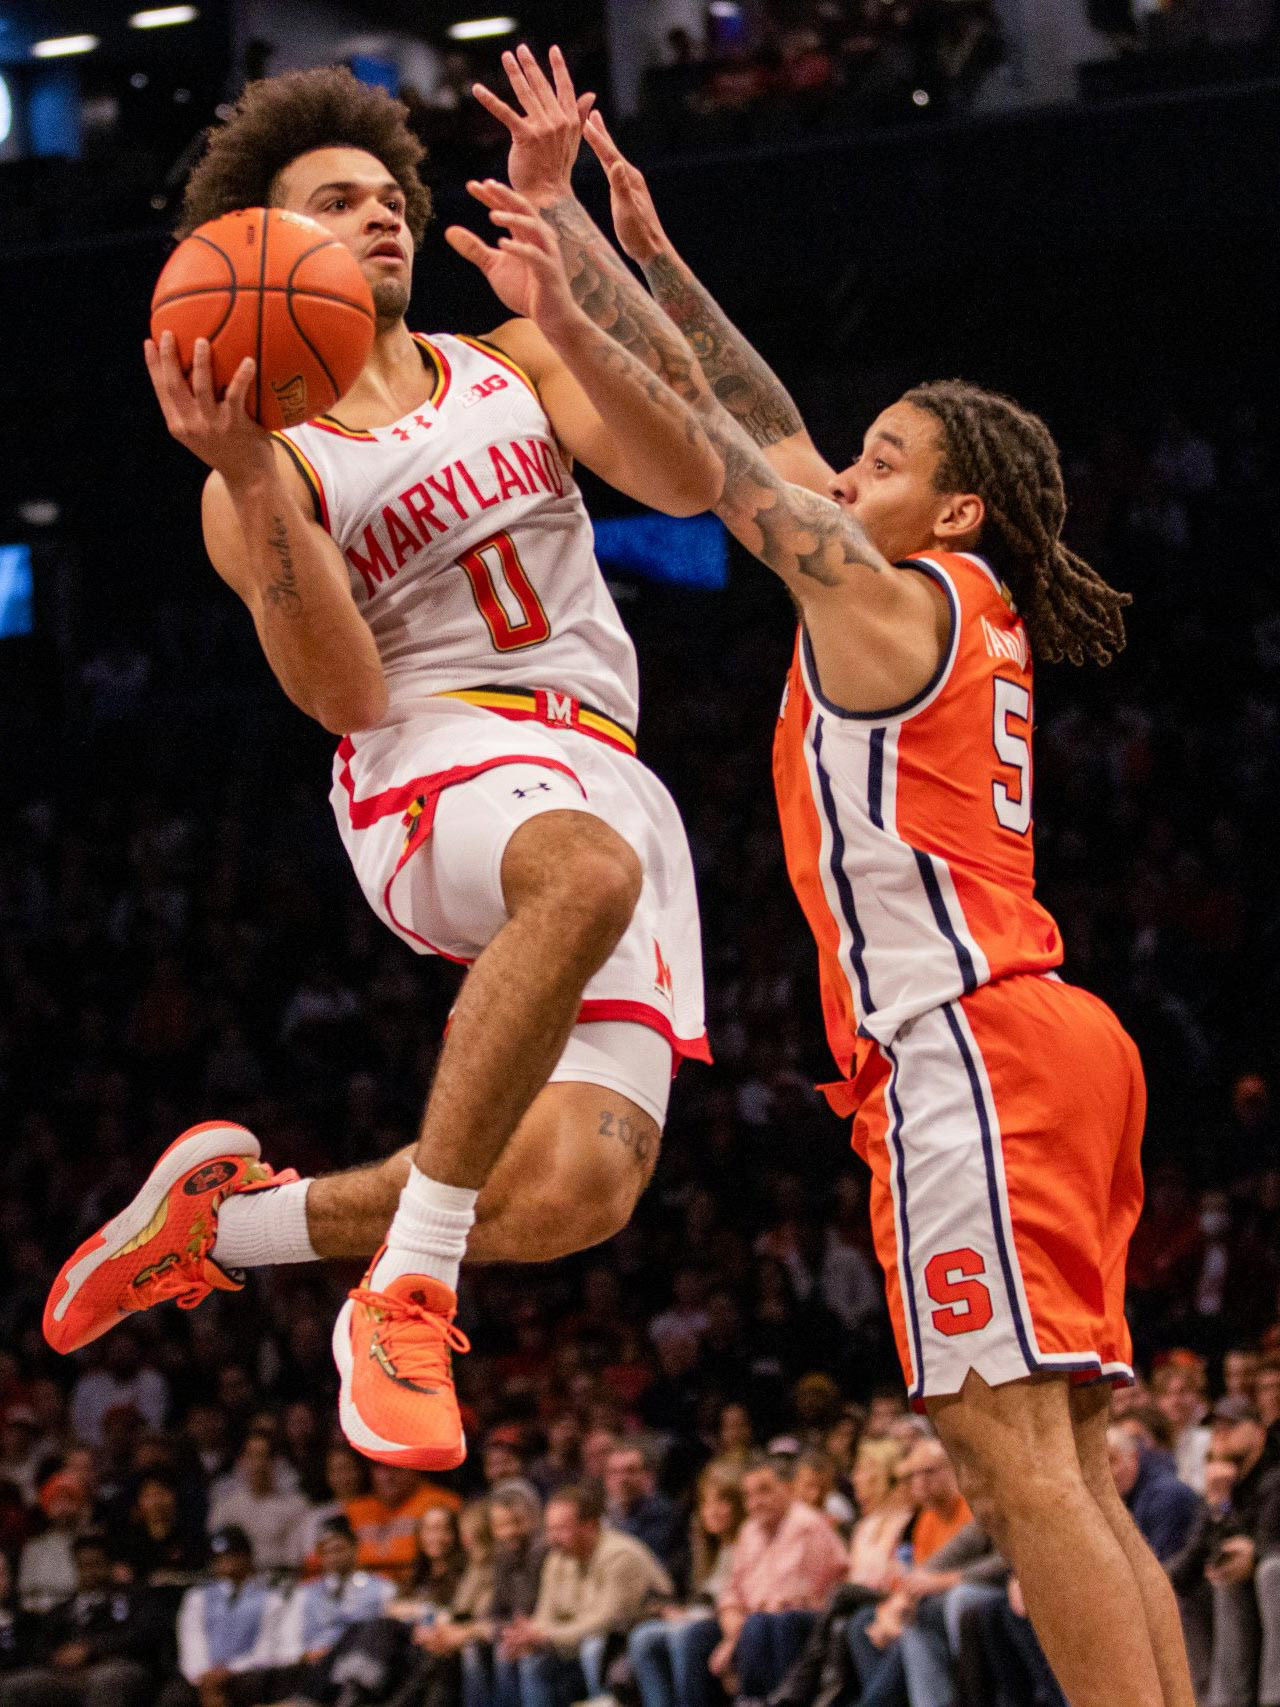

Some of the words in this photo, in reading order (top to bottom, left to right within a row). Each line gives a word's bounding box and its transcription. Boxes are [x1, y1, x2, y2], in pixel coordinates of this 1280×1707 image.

[345, 439, 563, 600] MARYLAND
[454, 528, 551, 653] 0
[546, 691, 572, 726] M
[992, 675, 1030, 837] 5
[924, 1247, 994, 1337] S
